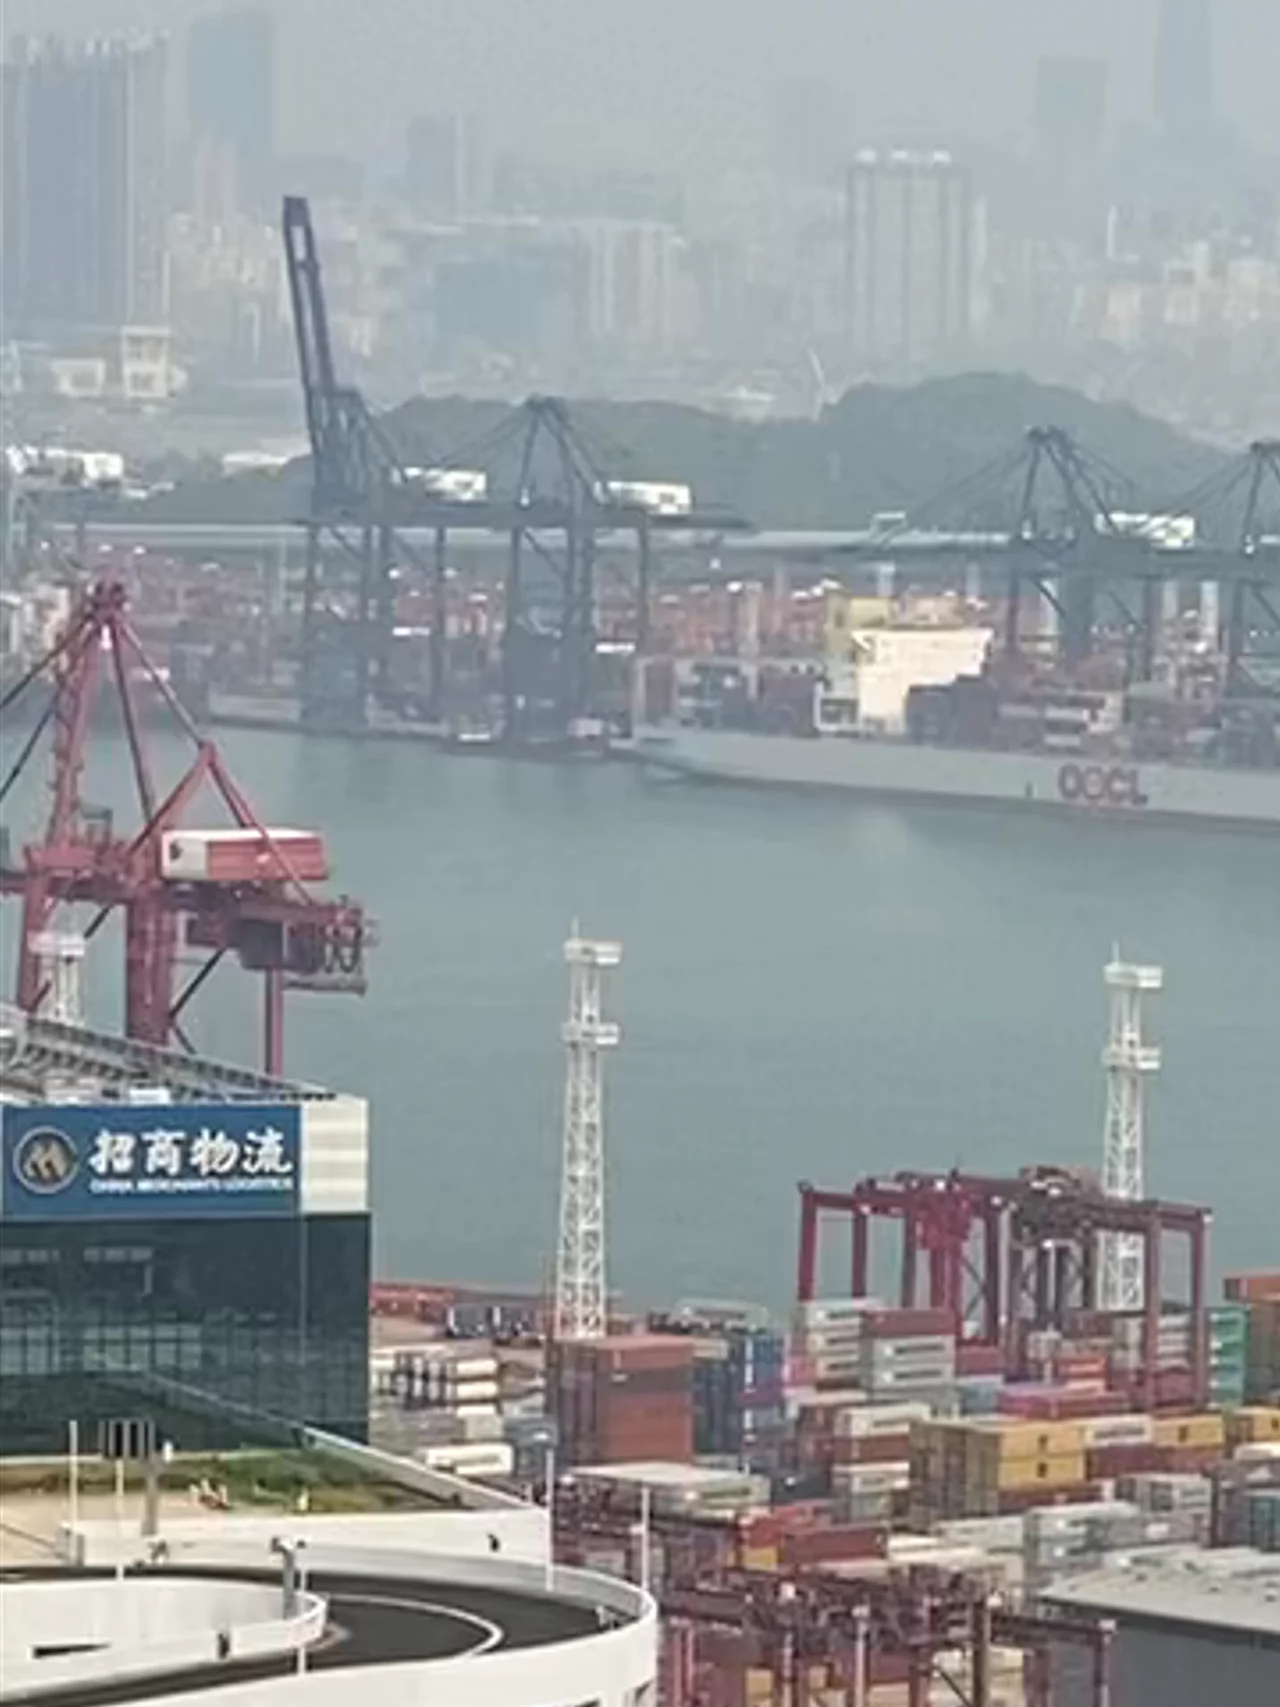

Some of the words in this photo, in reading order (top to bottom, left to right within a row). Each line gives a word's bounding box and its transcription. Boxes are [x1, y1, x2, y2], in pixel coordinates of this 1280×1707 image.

[1057, 762, 1149, 806] OOCL
[88, 1126, 295, 1176] 招商物流
